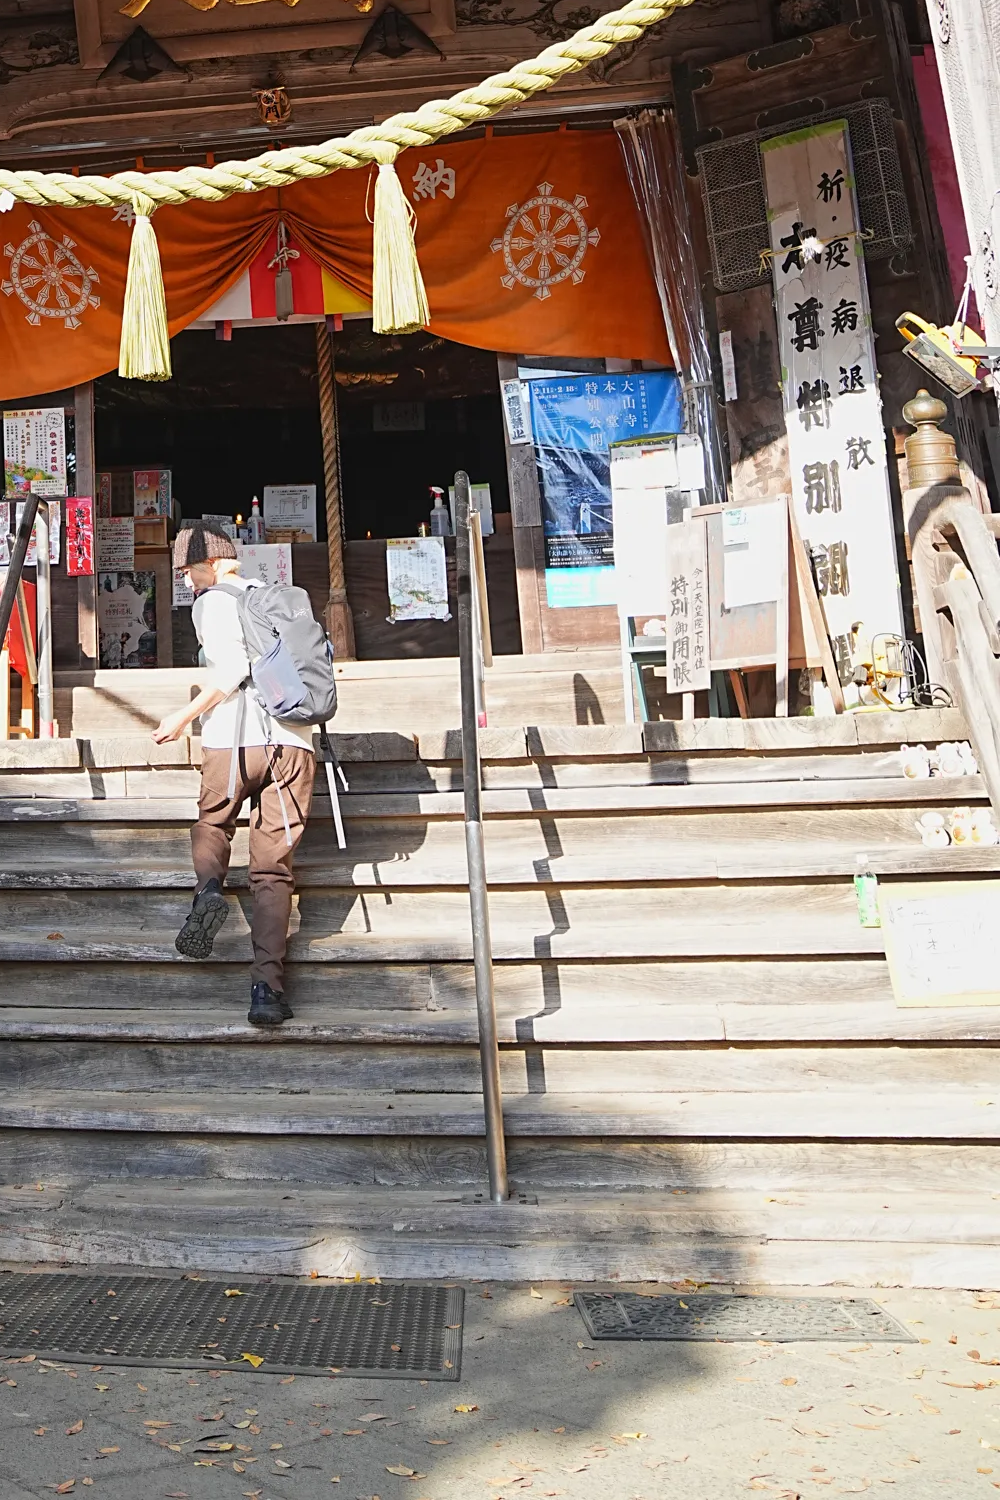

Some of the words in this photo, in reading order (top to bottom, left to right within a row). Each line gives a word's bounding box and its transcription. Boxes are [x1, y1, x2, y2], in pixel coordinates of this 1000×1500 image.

[412, 158, 456, 202] 納
[585, 381, 603, 447] 特別公開
[621, 380, 637, 428] 大山寺
[670, 576, 692, 687] 特別御開帳
[692, 566, 705, 670] 今上天皇陛下即位
